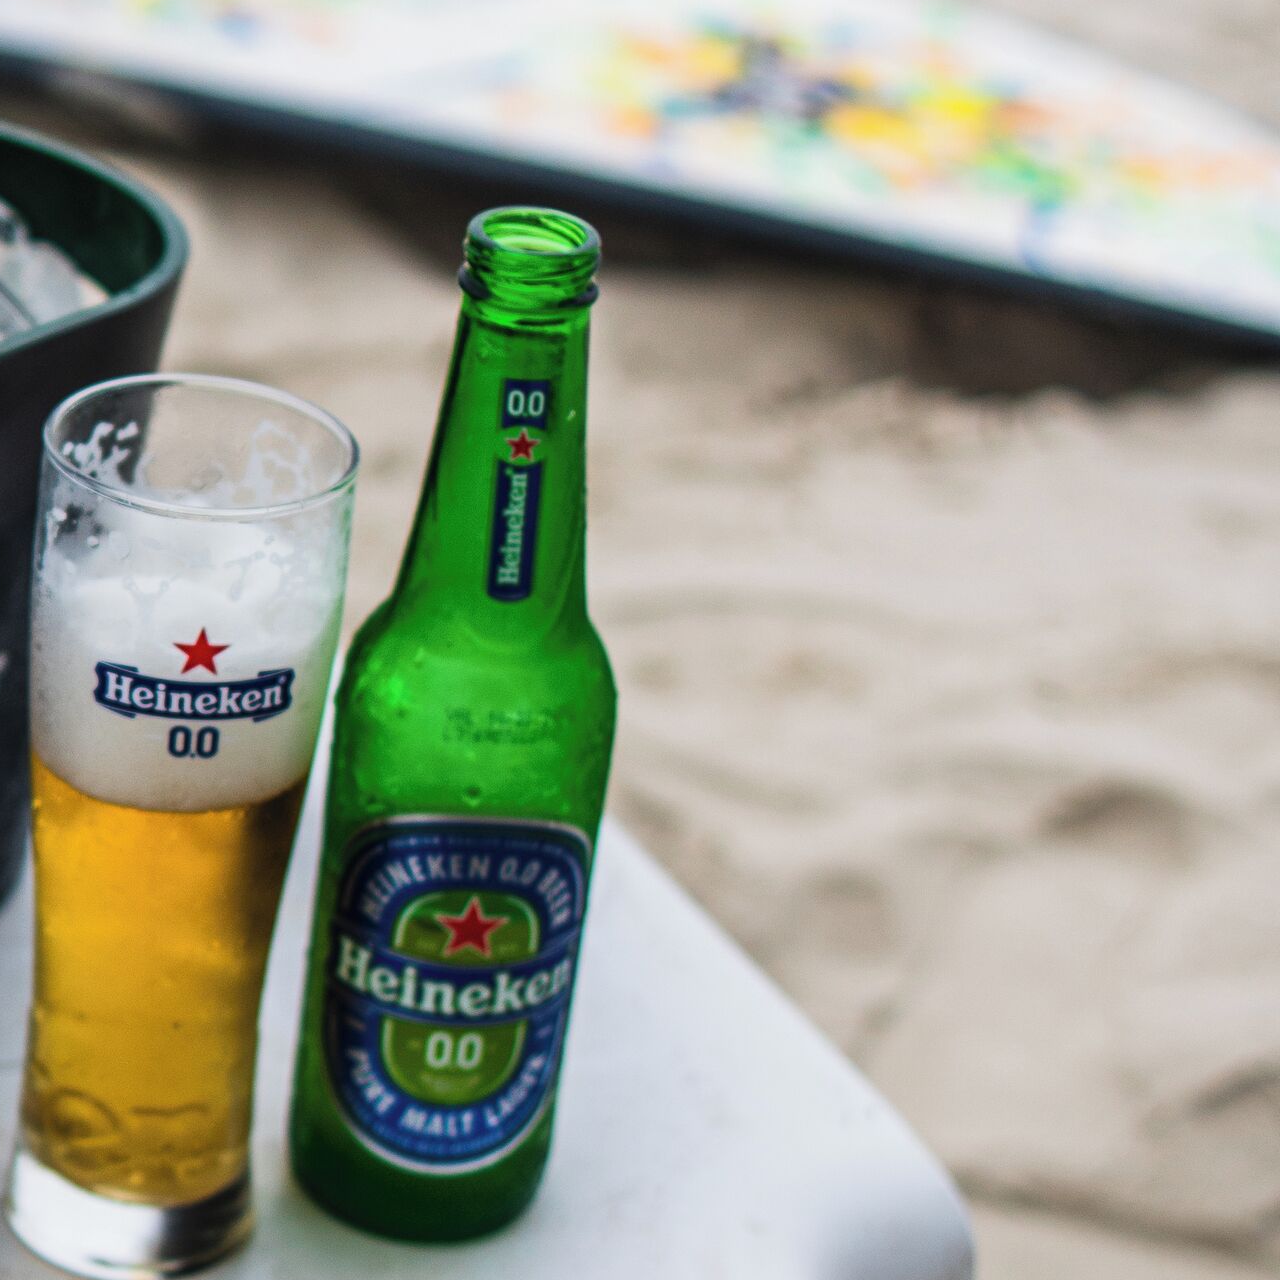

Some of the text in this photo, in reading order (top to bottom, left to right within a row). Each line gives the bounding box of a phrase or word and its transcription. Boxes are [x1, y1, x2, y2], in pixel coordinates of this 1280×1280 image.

[506, 389, 546, 418] 0.0
[496, 472, 529, 585] Heineken
[104, 671, 282, 716] Heineken
[167, 725, 220, 759] 0.0
[333, 933, 573, 1019] Heineken
[399, 1105, 475, 1139] MALT
